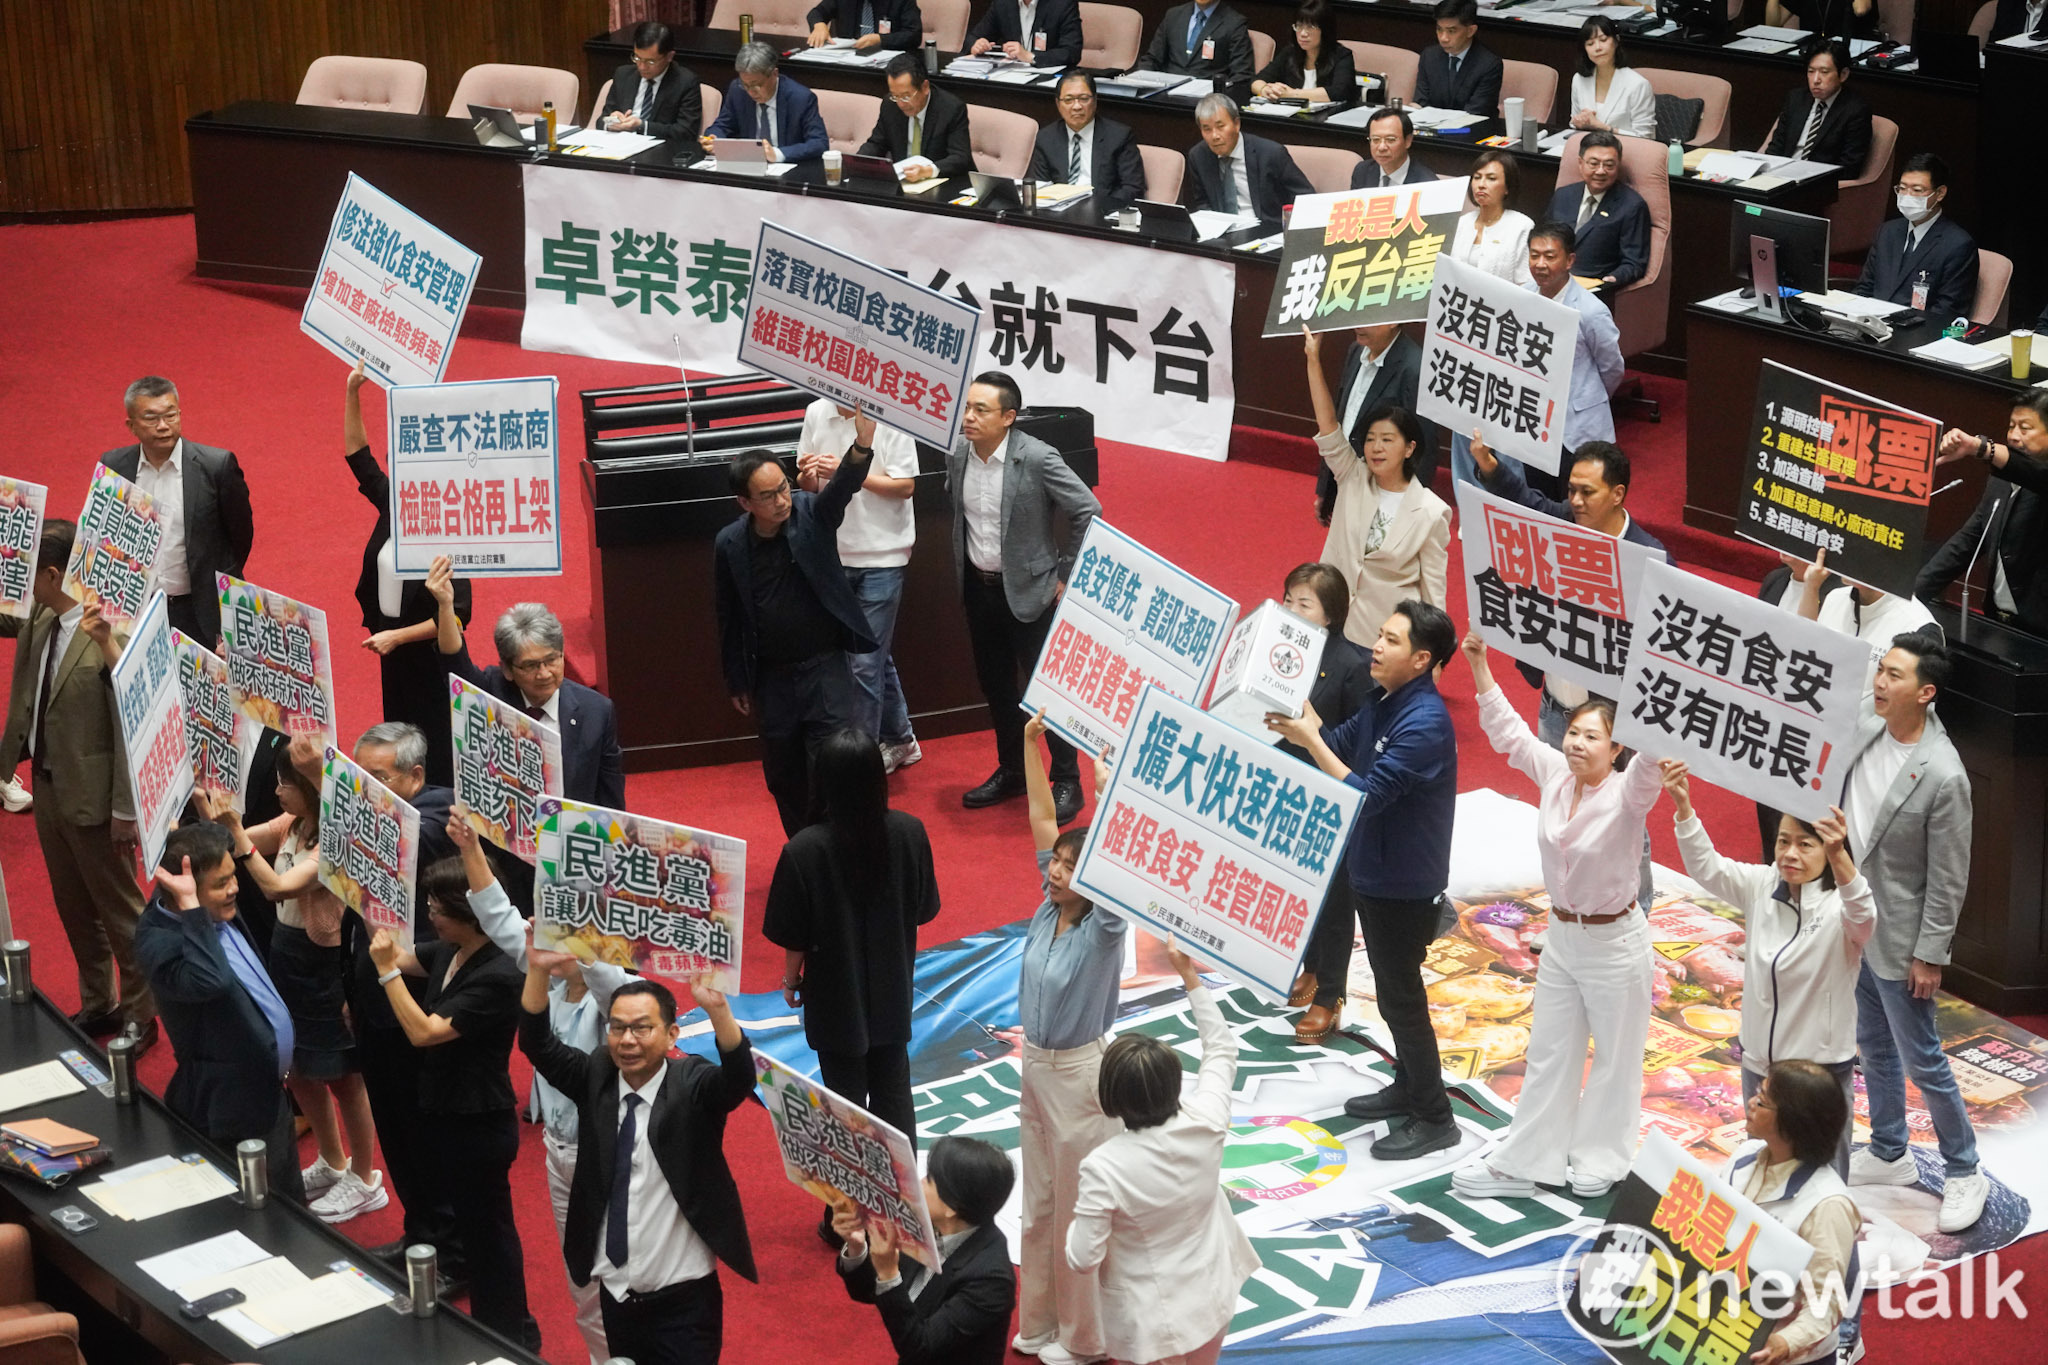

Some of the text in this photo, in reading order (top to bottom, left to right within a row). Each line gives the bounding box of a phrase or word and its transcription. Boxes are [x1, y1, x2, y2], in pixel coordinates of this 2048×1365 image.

[337, 200, 466, 315] 修法強化食安管理
[1324, 191, 1428, 246] 我是人
[535, 220, 753, 324] 卓榮泰
[760, 248, 966, 366] 落實校園食安機制
[1278, 233, 1446, 324] 我反台毒
[321, 268, 442, 367] 增加查廠檢驗頻率
[1437, 284, 1554, 376] 沒有食安
[751, 306, 953, 422] 維護校園飲食安全
[398, 408, 550, 455] 嚴查不法廠商
[1777, 432, 1857, 478] 重建生產管理
[1780, 406, 1835, 443] 源頭控管
[1824, 406, 1931, 498] 跳票
[85, 488, 161, 568] 官員無能
[399, 476, 552, 539] 檢驗合格再上架
[1765, 507, 1844, 555] 全民監督食安
[1769, 482, 1905, 550] 加重惡意黑心廠商責任
[0, 557, 29, 601] 害
[70, 538, 146, 617] 人民受害
[1071, 545, 1217, 667] 食安優先 資訊透明
[1494, 520, 1619, 611] 跳票
[235, 605, 313, 677] 民進黨
[1041, 618, 1184, 729] 保障消費者
[1279, 622, 1311, 650] 毒油
[1647, 593, 1833, 713] 沒有食安
[180, 659, 233, 735] 民進黨
[228, 652, 327, 724] 做不好就下台
[466, 707, 544, 795] 民進黨
[1131, 710, 1344, 877] 擴大快速檢驗
[333, 779, 400, 870] 民進黨
[320, 824, 407, 922] 讓人民吃毒油
[563, 832, 710, 911] 民進黨
[1101, 800, 1310, 951] 確保食安 控管風險
[542, 884, 731, 963] 讓人民吃毒油
[657, 955, 712, 972] 毒蘋果
[779, 1131, 924, 1241] 做不好就下台
[782, 1090, 898, 1193] 民進黨
[1255, 1184, 1308, 1200] PARTY
[1651, 1166, 1760, 1293] 我是人
